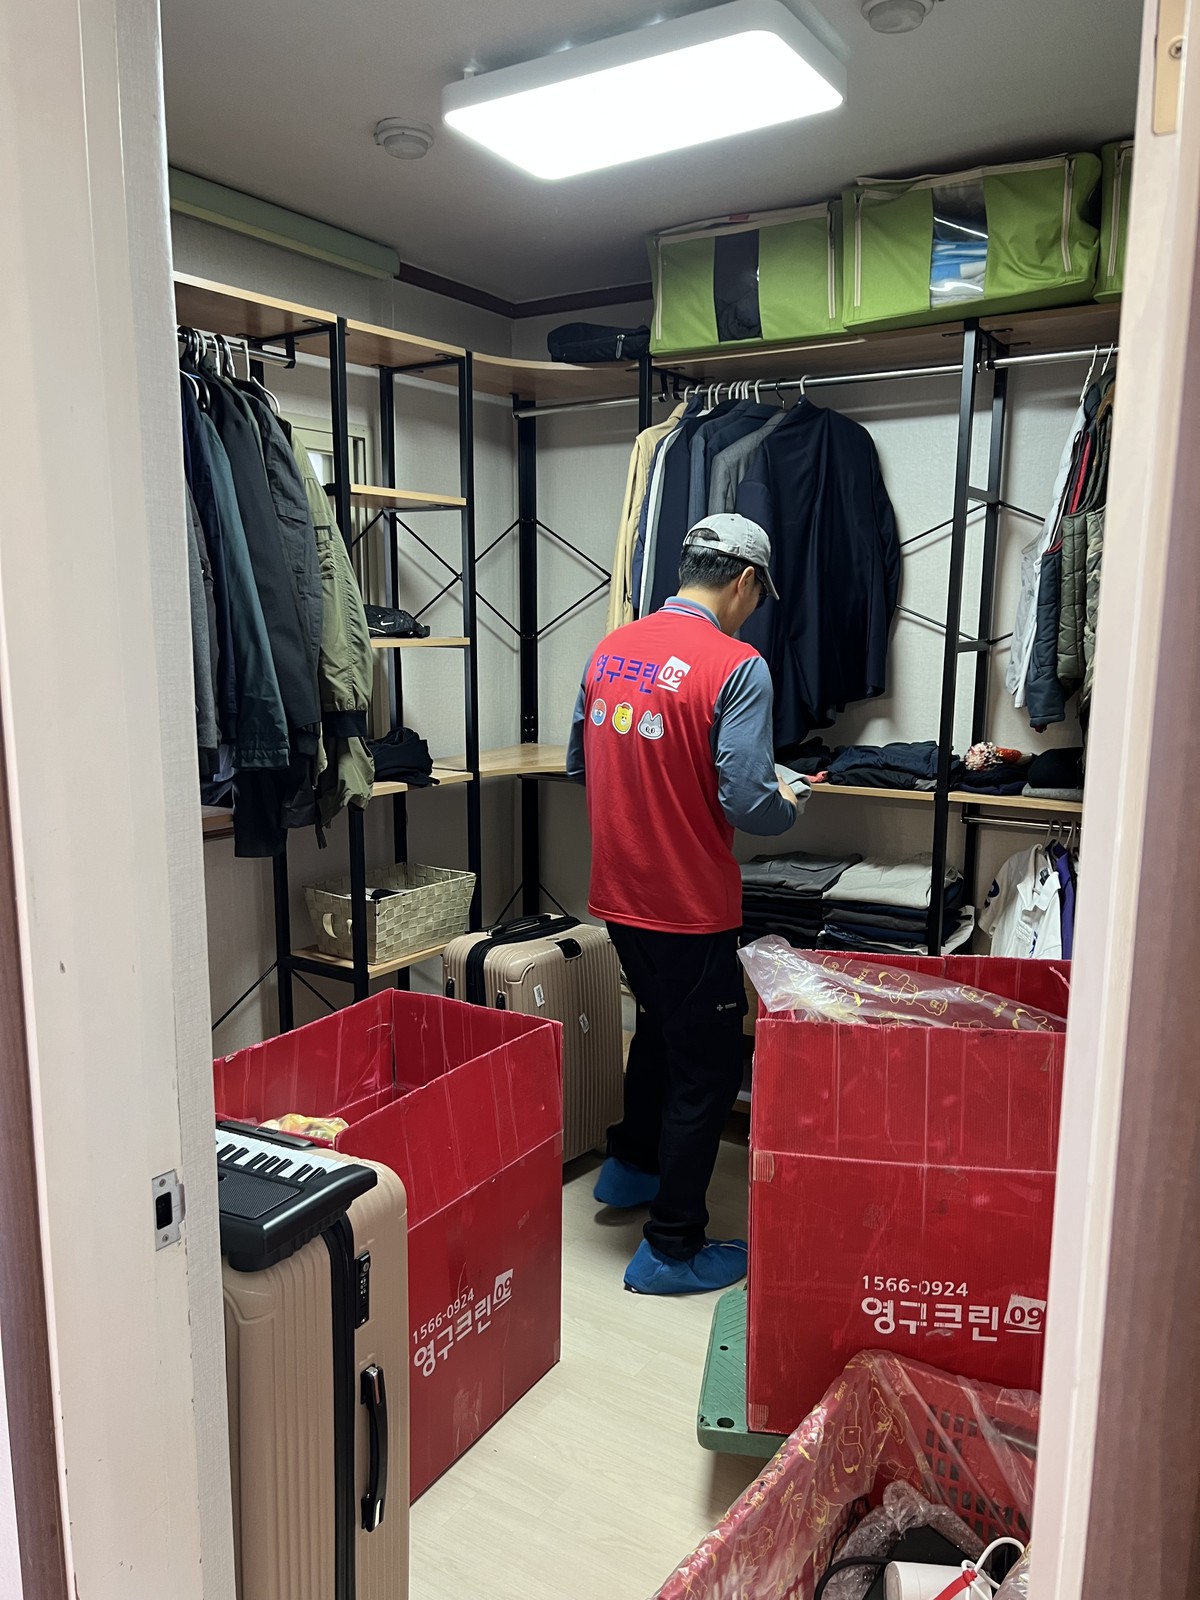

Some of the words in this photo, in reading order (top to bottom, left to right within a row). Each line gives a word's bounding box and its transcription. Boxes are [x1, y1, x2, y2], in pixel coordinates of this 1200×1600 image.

[594, 654, 660, 694] 영구크린
[862, 1274, 968, 1297] 1566-0924
[412, 1287, 475, 1345] 1566-0924
[413, 1294, 492, 1377] 영구크린
[861, 1297, 1000, 1342] 영구크린
